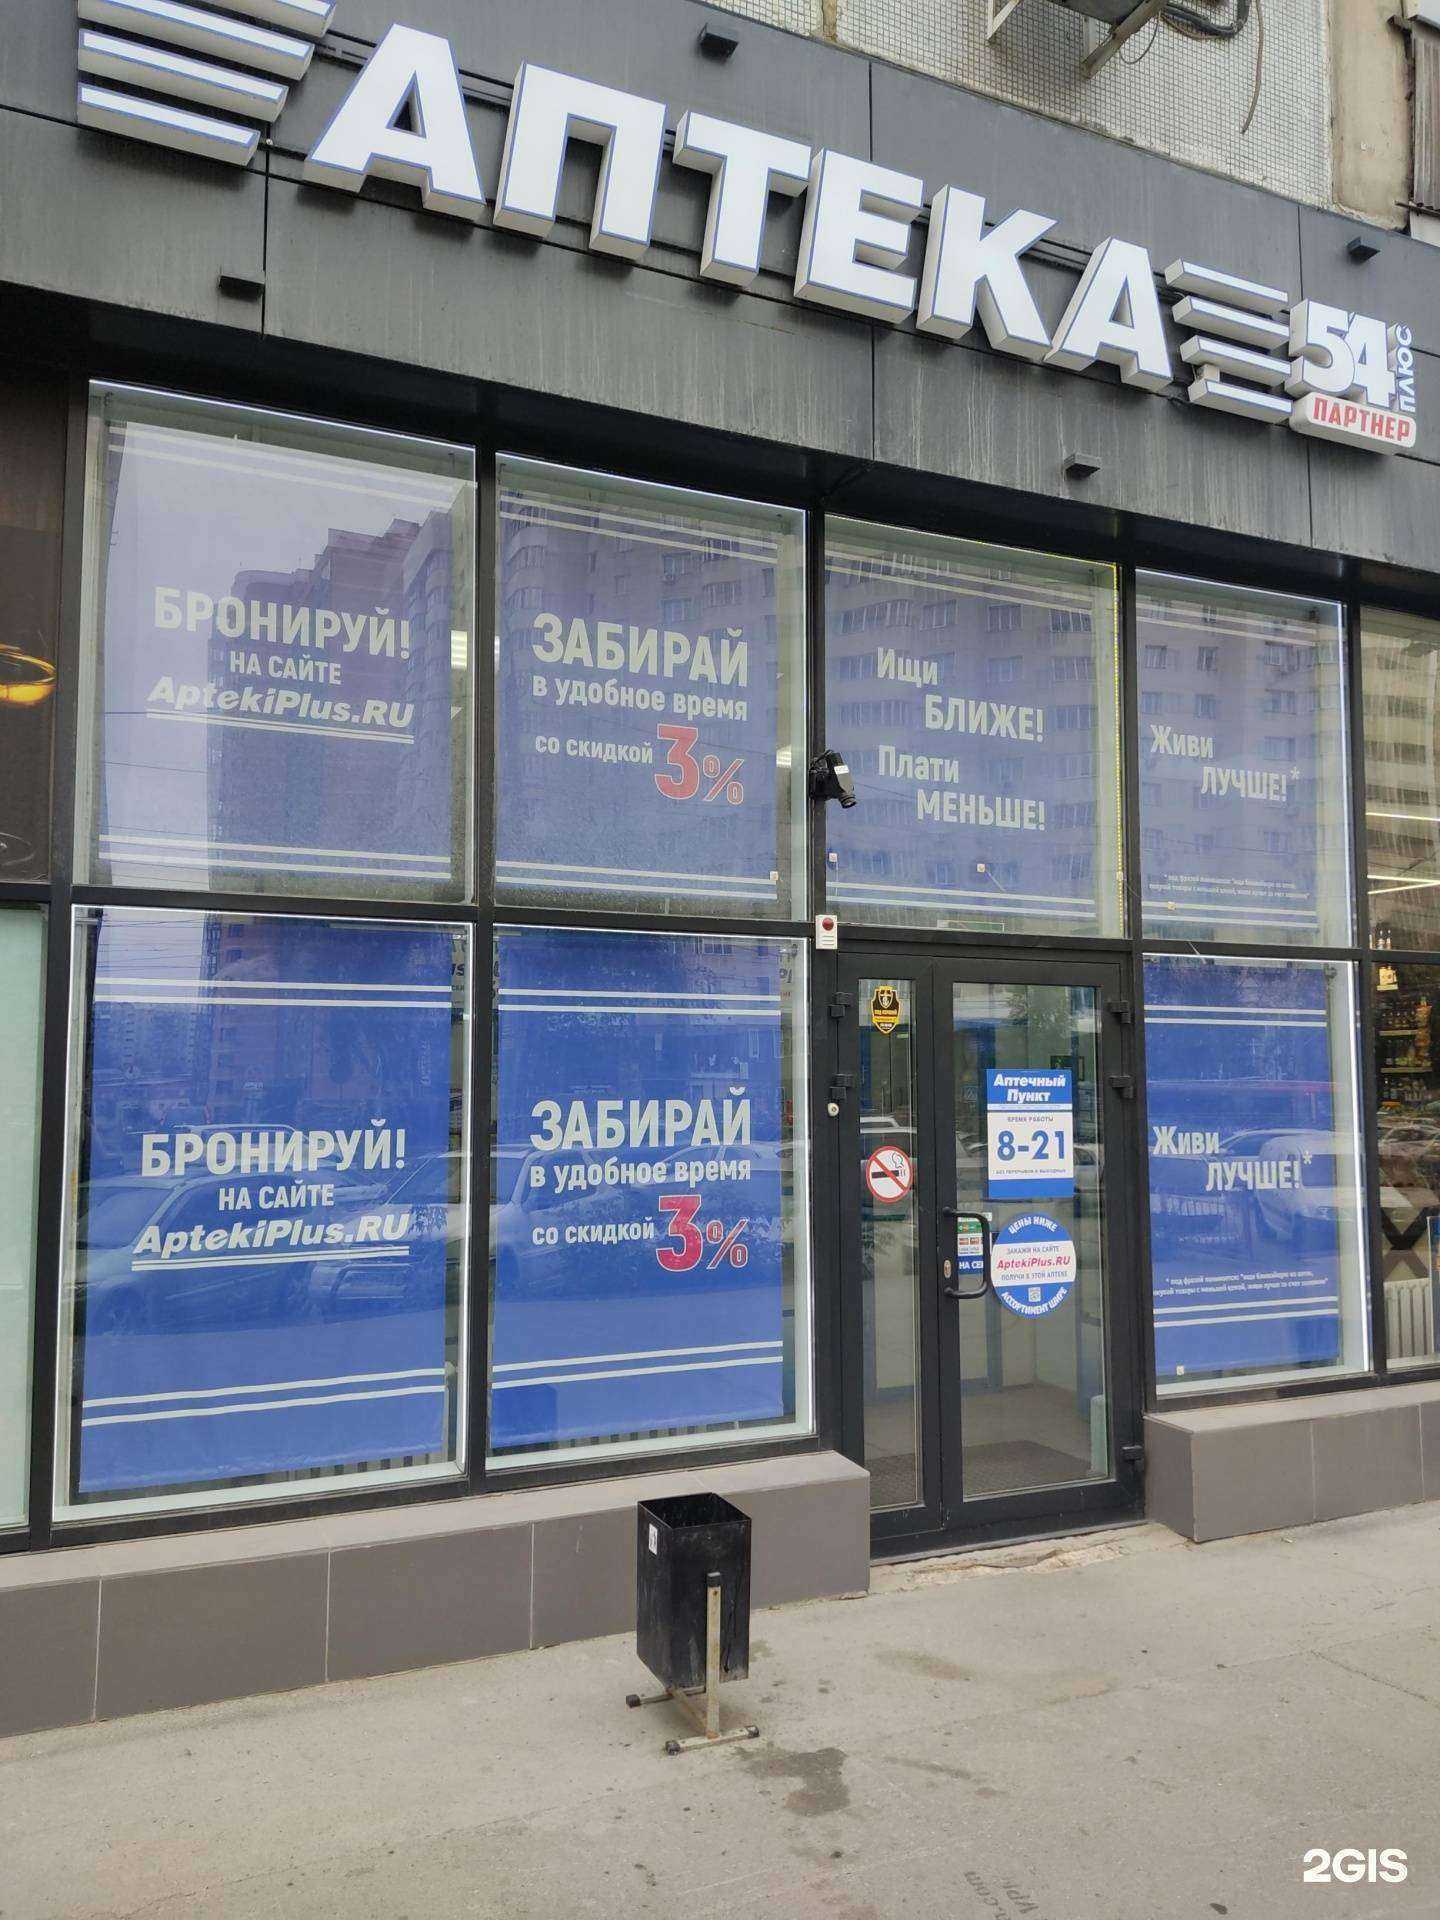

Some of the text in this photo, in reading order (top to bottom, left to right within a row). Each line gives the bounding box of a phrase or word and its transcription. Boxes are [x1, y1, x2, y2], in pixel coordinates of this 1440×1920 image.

[308, 23, 1173, 386] АПТЕКА
[1301, 300, 1396, 409] 54
[1396, 323, 1416, 413] ПЛЮС
[1313, 396, 1411, 442] ПАРТНЕР
[154, 586, 411, 660] БРОНИРУЙ!
[229, 650, 342, 685] НА САЙТЕ
[531, 612, 748, 688] ЗАБИРАЙ
[877, 647, 938, 688] Ищи
[147, 675, 415, 729] AptekiPlus.RU
[532, 675, 748, 721] в удобное время
[925, 694, 1044, 742] БЛИЖЕ!
[535, 723, 745, 805] со скидкой 3%
[878, 744, 960, 783] Плати
[1150, 724, 1215, 758] Живи
[916, 789, 1046, 831] МЕНЬШЕ!
[993, 1073, 1067, 1088] Аптечный
[1006, 1088, 1051, 1104] Пункт
[530, 1086, 751, 1150] ЗАБИРАЙ
[1152, 1125, 1220, 1155] Живи
[141, 1118, 406, 1177] БРОНИРУЙ!
[997, 1130, 1065, 1162] 8-21
[218, 1179, 335, 1211] НА САЙТЕ
[530, 1156, 751, 1194] в удобное время
[132, 1213, 411, 1259] AptekiPlus.RU
[532, 1194, 749, 1272] со скидкой 3%
[1033, 1215, 1058, 1232] НИЖЕ
[996, 1255, 1071, 1271] AptekiPlus.RU
